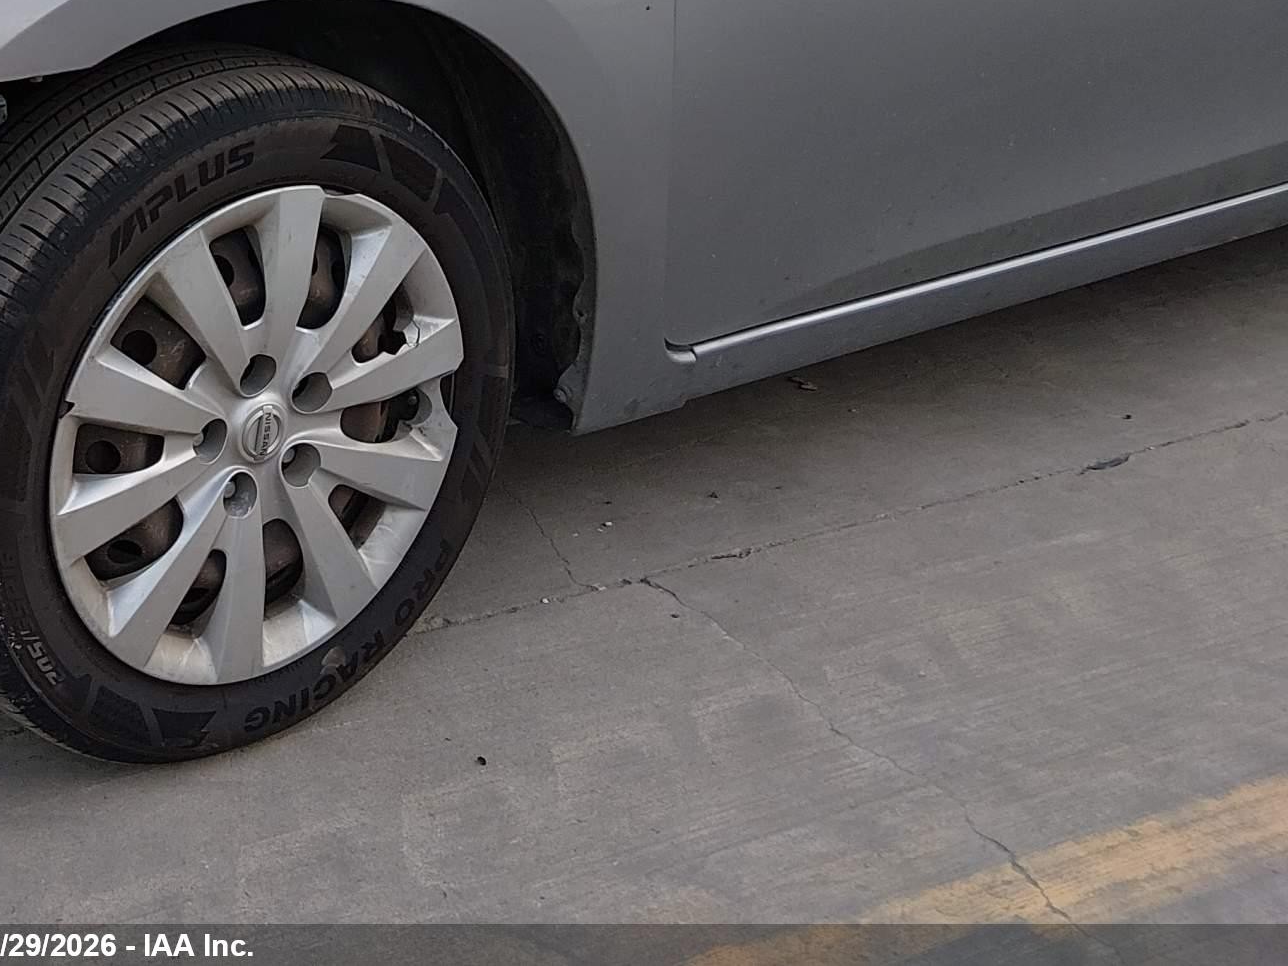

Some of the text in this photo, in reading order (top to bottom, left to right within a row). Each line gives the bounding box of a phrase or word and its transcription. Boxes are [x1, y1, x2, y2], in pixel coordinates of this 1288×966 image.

[260, 411, 273, 458] NISSAN
[394, 538, 458, 629] PRO
[243, 629, 387, 734] RACING
